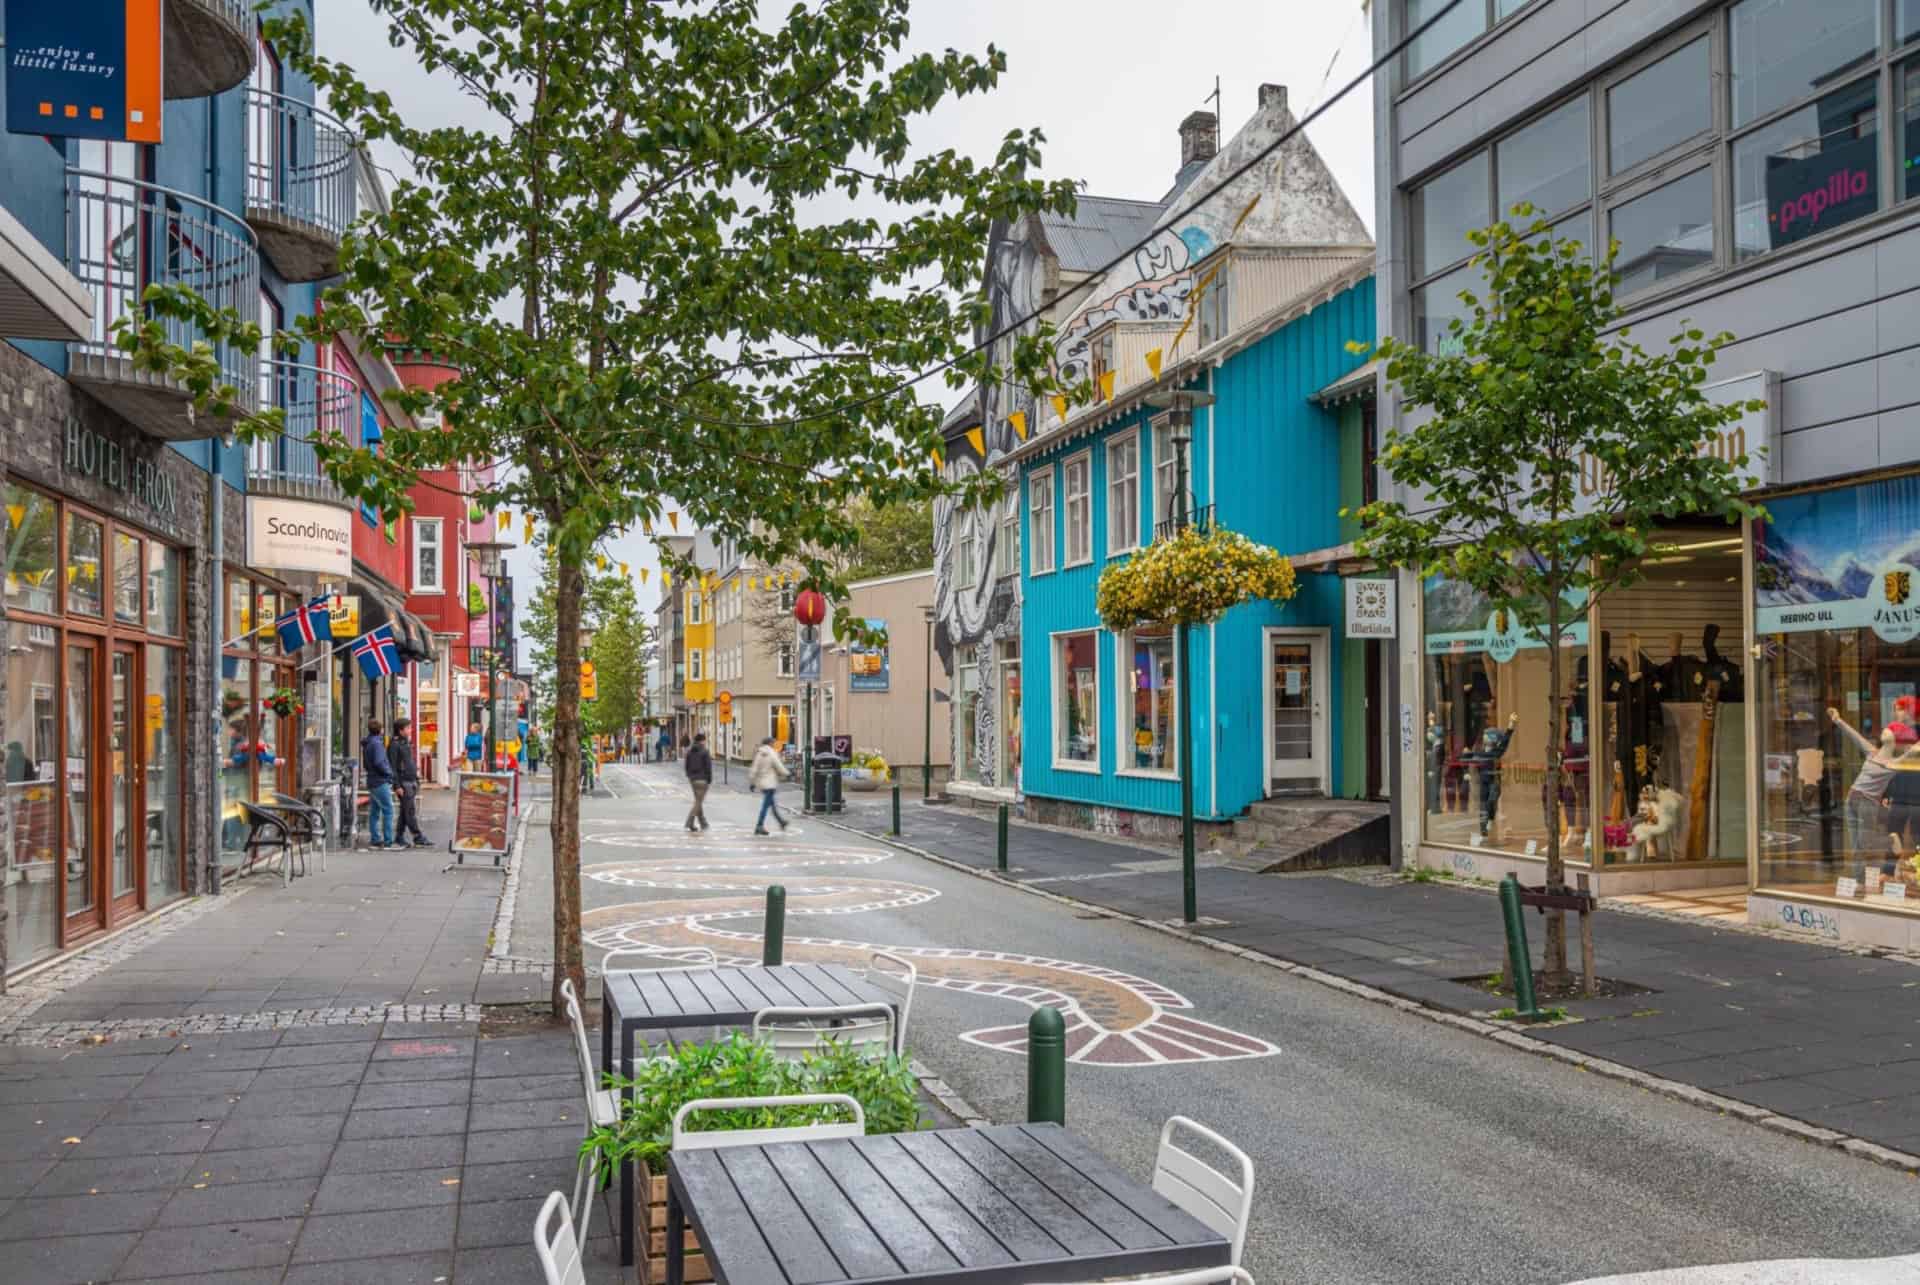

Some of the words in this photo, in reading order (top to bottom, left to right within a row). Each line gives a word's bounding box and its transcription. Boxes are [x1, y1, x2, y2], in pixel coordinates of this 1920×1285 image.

[14, 54, 56, 69] little
[62, 60, 115, 78] luxury
[86, 52, 95, 60] a
[1780, 168, 1868, 233] papilla
[66, 416, 128, 492] HOTEL
[1780, 612, 1816, 624] MERINO
[1818, 611, 1833, 621] ULL
[1874, 607, 1920, 623] JANUS
